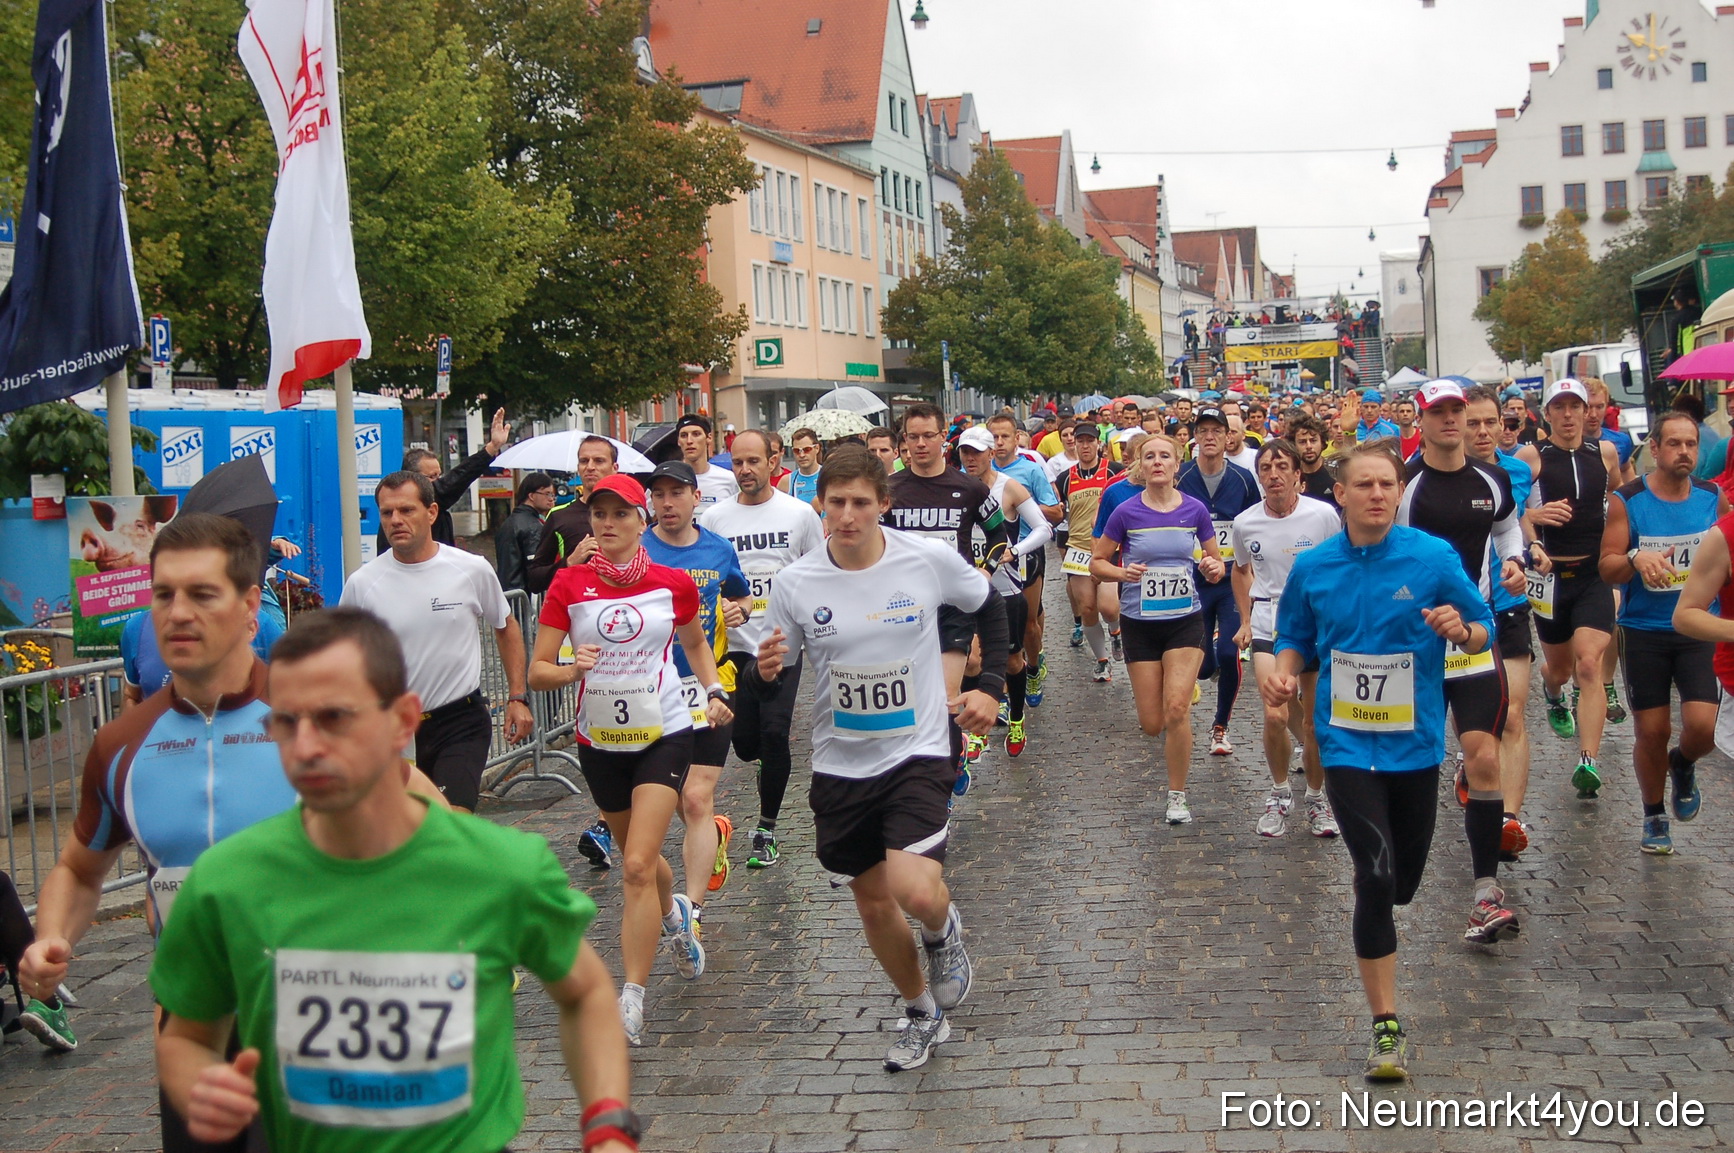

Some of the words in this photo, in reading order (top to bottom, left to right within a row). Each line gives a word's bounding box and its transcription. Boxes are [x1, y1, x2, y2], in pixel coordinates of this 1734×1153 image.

[154, 323, 167, 358] P
[441, 342, 449, 369] P
[760, 342, 778, 362] D
[1261, 346, 1300, 358] START
[891, 508, 962, 529] THULE
[685, 569, 720, 580] ARKTER
[82, 587, 110, 601] BEIDE
[111, 579, 152, 596] STIMME
[1146, 578, 1189, 598] 3173
[108, 593, 136, 608] GRÜN
[813, 625, 837, 635] PARTL
[1333, 657, 1357, 669] PARTL
[1358, 662, 1399, 671] Neumarkt
[1444, 656, 1471, 671] Daniel
[830, 669, 855, 681] PARTL
[857, 669, 898, 681] Neumarkt
[586, 687, 607, 696] PARTL
[608, 687, 646, 696] Neumarkt
[681, 687, 700, 708] 2
[837, 679, 907, 711] 3160
[1355, 673, 1388, 702] 87
[613, 699, 630, 725] 3
[692, 714, 702, 722] an
[1352, 707, 1389, 721] Steven
[600, 730, 649, 744] Stephanie
[281, 969, 344, 986] PARTL
[350, 971, 439, 989] Neumarkt
[297, 995, 453, 1062] 2337
[329, 1077, 423, 1102] Damian
